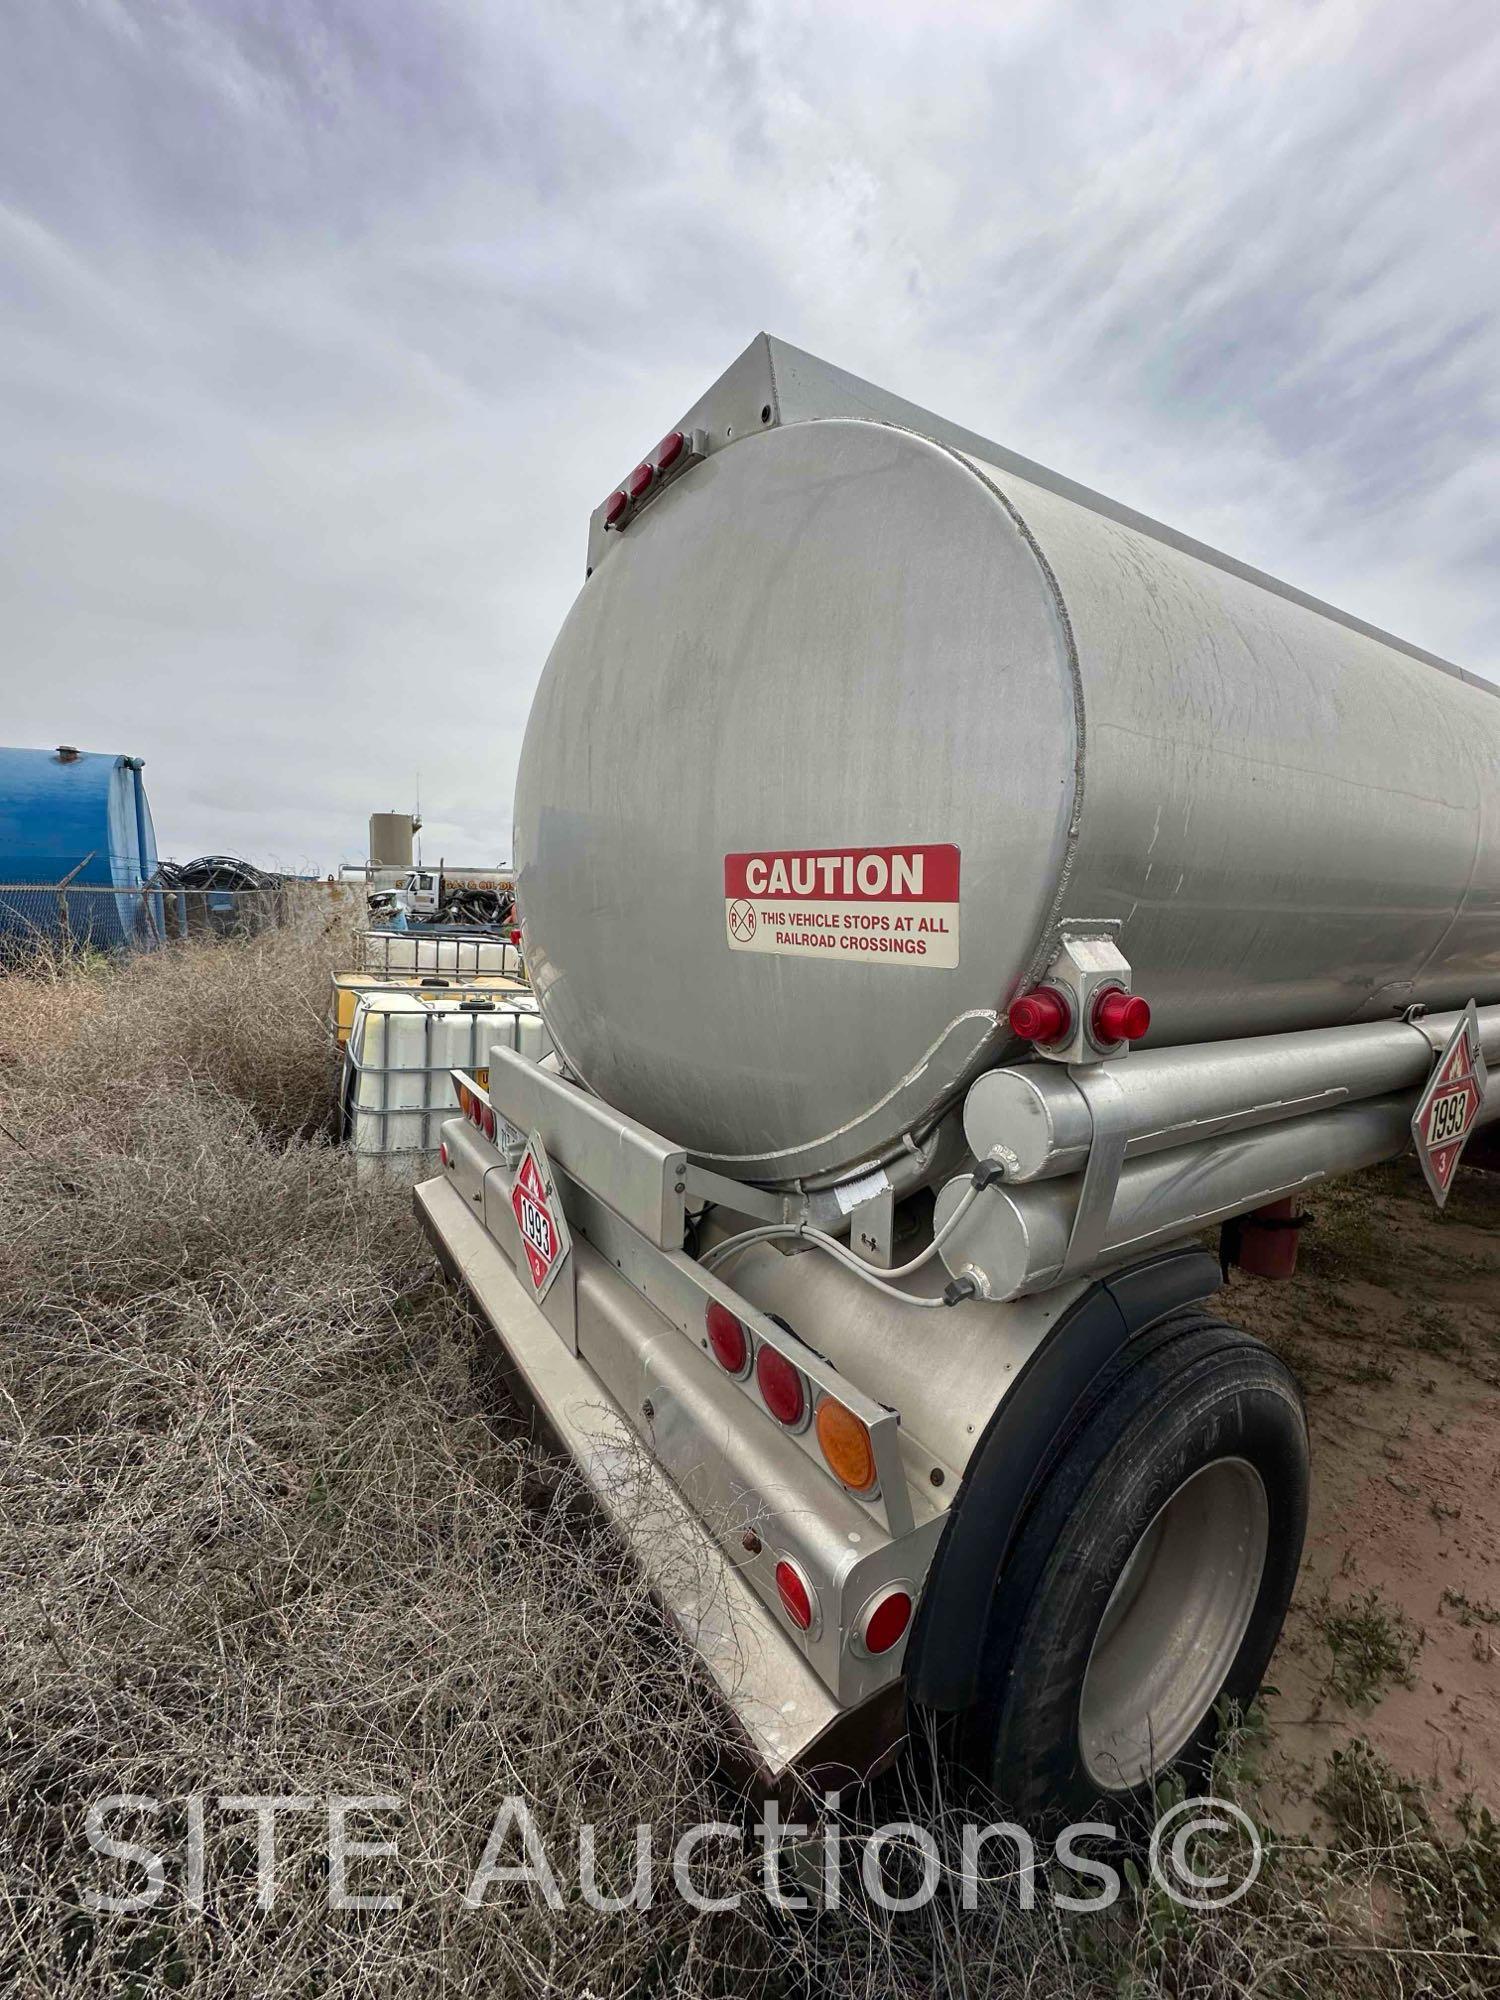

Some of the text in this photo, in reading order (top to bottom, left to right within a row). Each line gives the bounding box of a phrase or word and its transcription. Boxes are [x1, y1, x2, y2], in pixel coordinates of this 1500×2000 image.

[478, 881, 498, 890] OIL
[745, 853, 924, 896] CAUTION
[761, 911, 949, 934] THIS VEHICLE STOPS AT ALL
[776, 931, 927, 955] RAILROAD CROSSINGS
[1431, 1092, 1466, 1142] 1993
[1438, 1152, 1447, 1173] 3
[521, 1198, 551, 1257] 1993
[534, 1259, 541, 1277] 3
